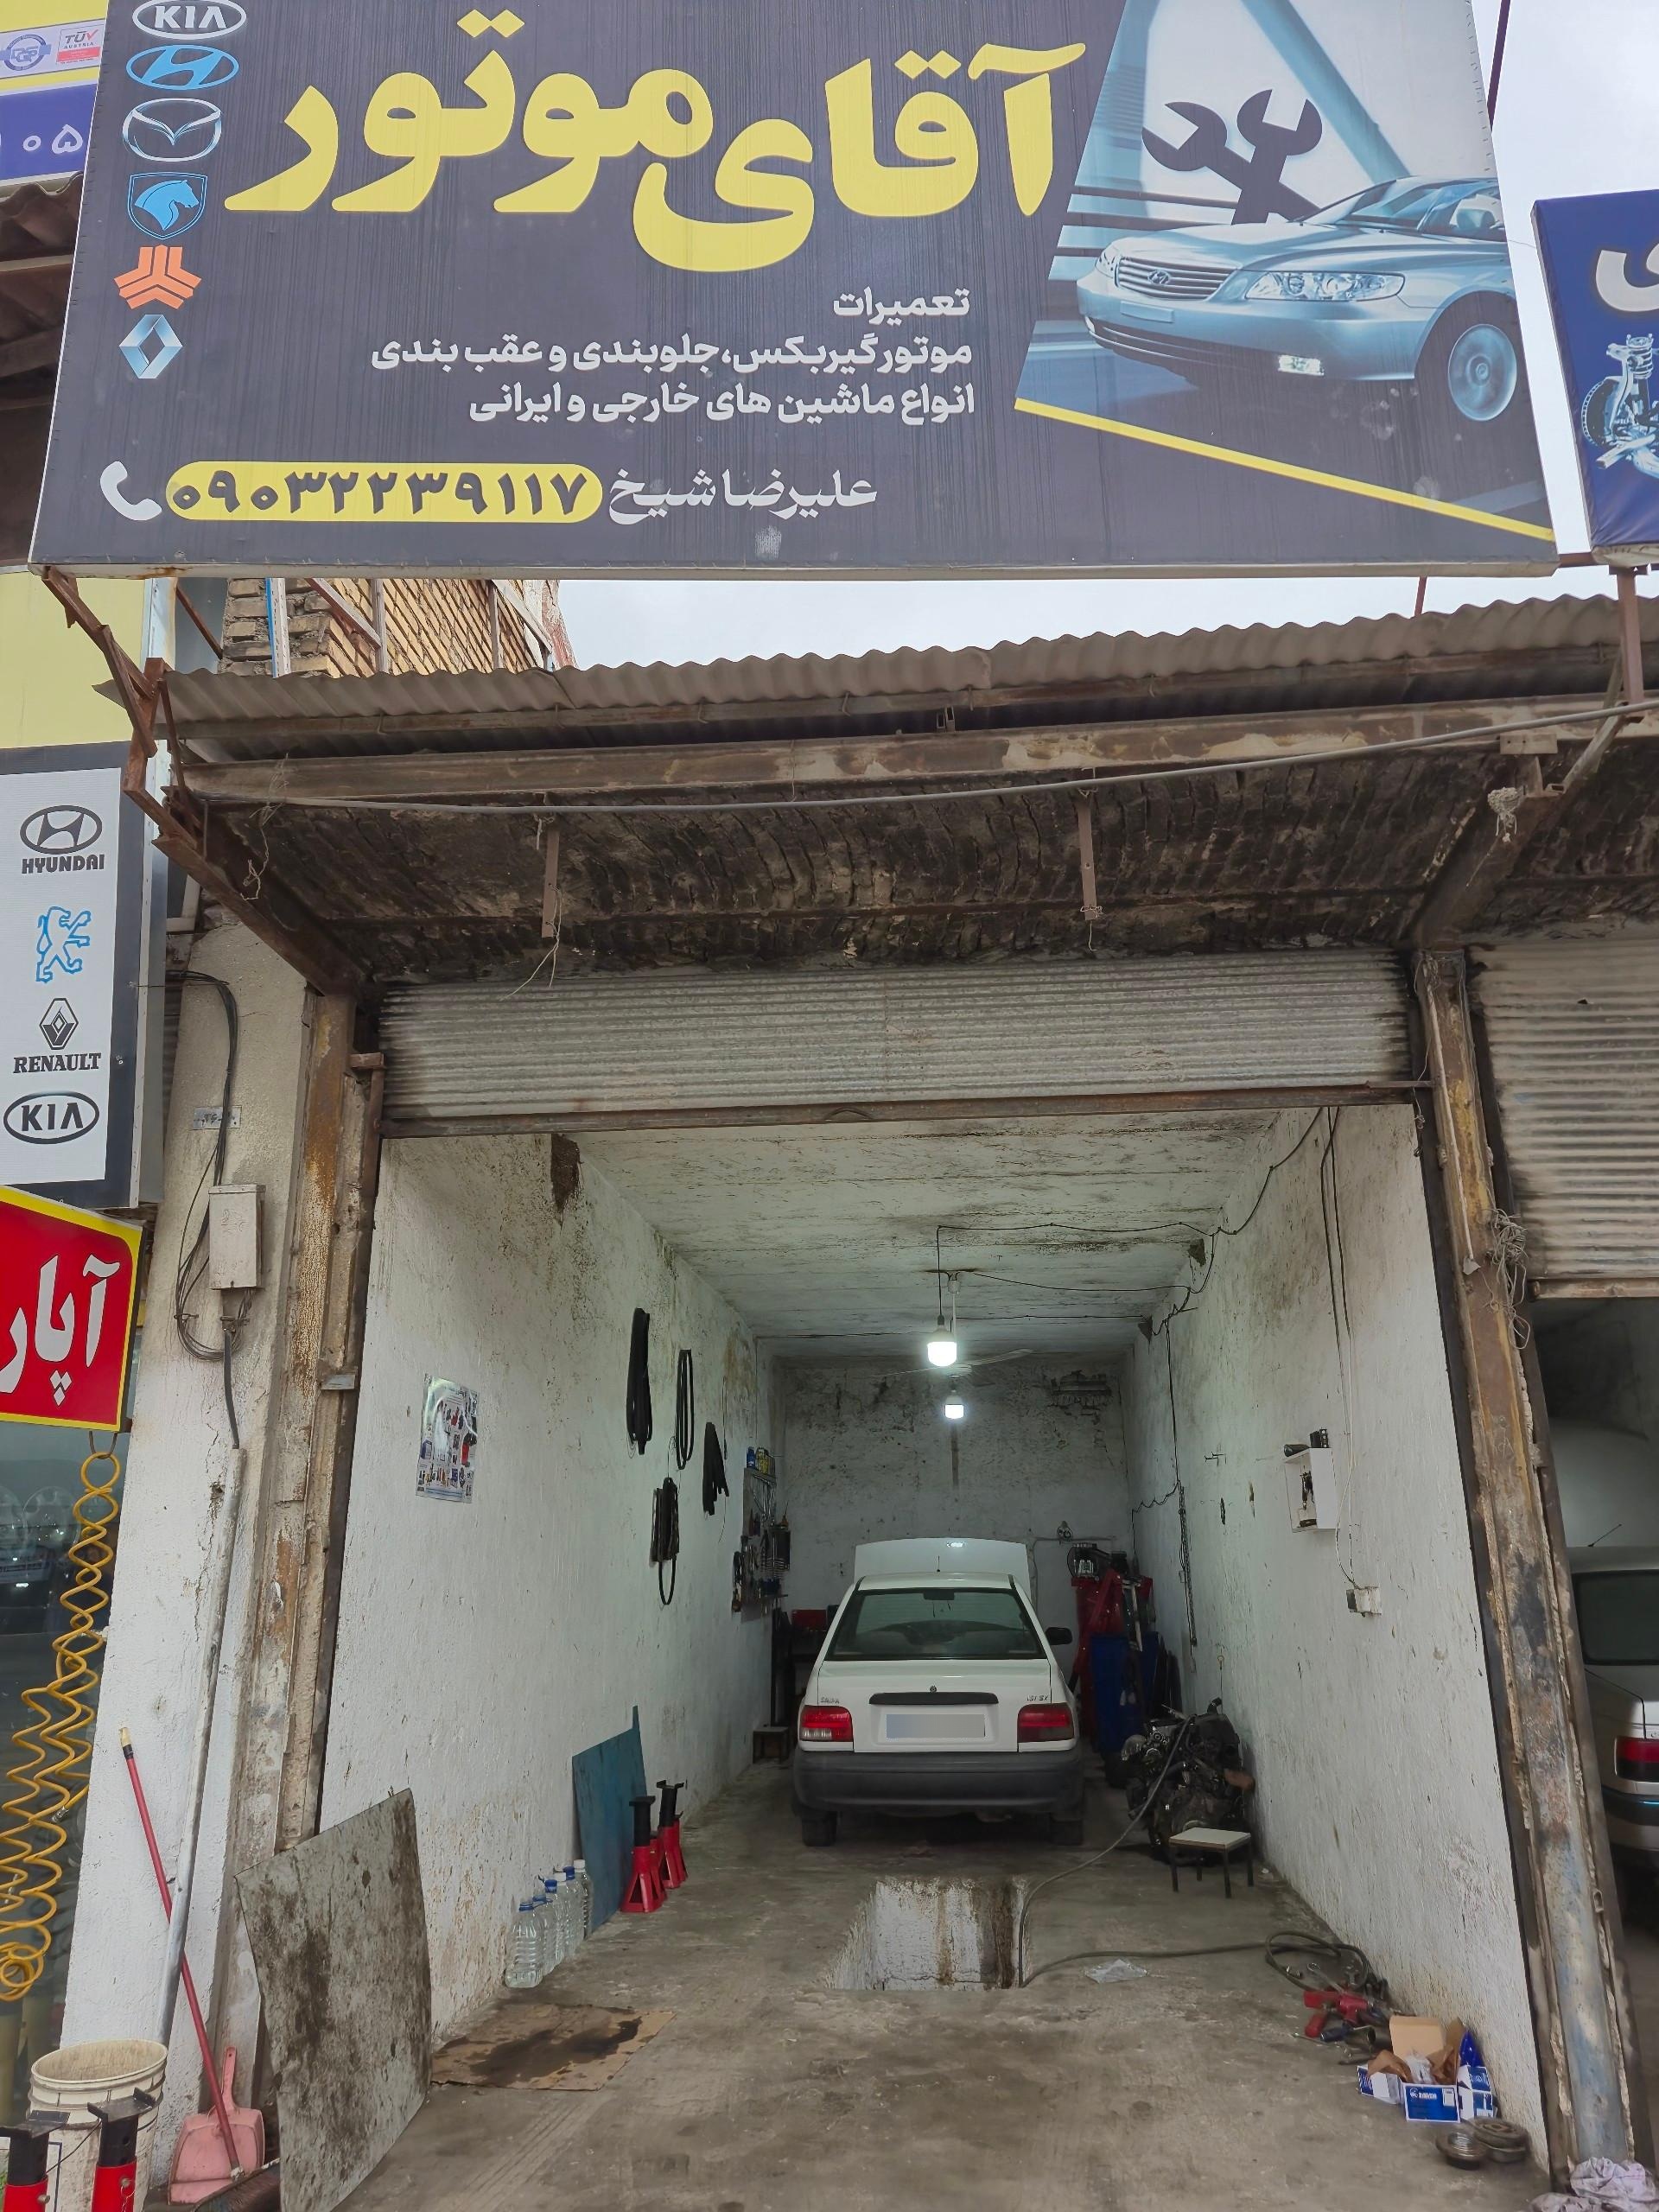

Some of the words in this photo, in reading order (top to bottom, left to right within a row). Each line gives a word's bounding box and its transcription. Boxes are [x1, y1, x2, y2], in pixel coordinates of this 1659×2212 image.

[154, 3, 227, 29] KIA
[224, 10, 714, 213] موتور
[0, 124, 84, 155] ۰۵
[632, 44, 1085, 272] آقای
[833, 285, 970, 327] تعمیرات
[371, 338, 459, 373] بندی
[464, 334, 543, 373] عقب
[548, 346, 568, 372] و
[573, 332, 720, 374] جلوبندی
[876, 335, 972, 374] موتور
[469, 381, 562, 423] ایرانی
[566, 394, 586, 423] و
[592, 381, 700, 423] خارجی
[706, 382, 772, 423] های
[778, 382, 895, 424] ماشین
[900, 382, 975, 426] انواع
[172, 470, 588, 516] ۰۹۰۳۲۲۳۹۱۱۷
[608, 468, 716, 525] شیخ
[721, 468, 878, 520] علیرضا
[21, 854, 105, 874] HYUNDAI
[12, 1052, 102, 1074] RENAULT
[21, 1102, 84, 1132] KIA
